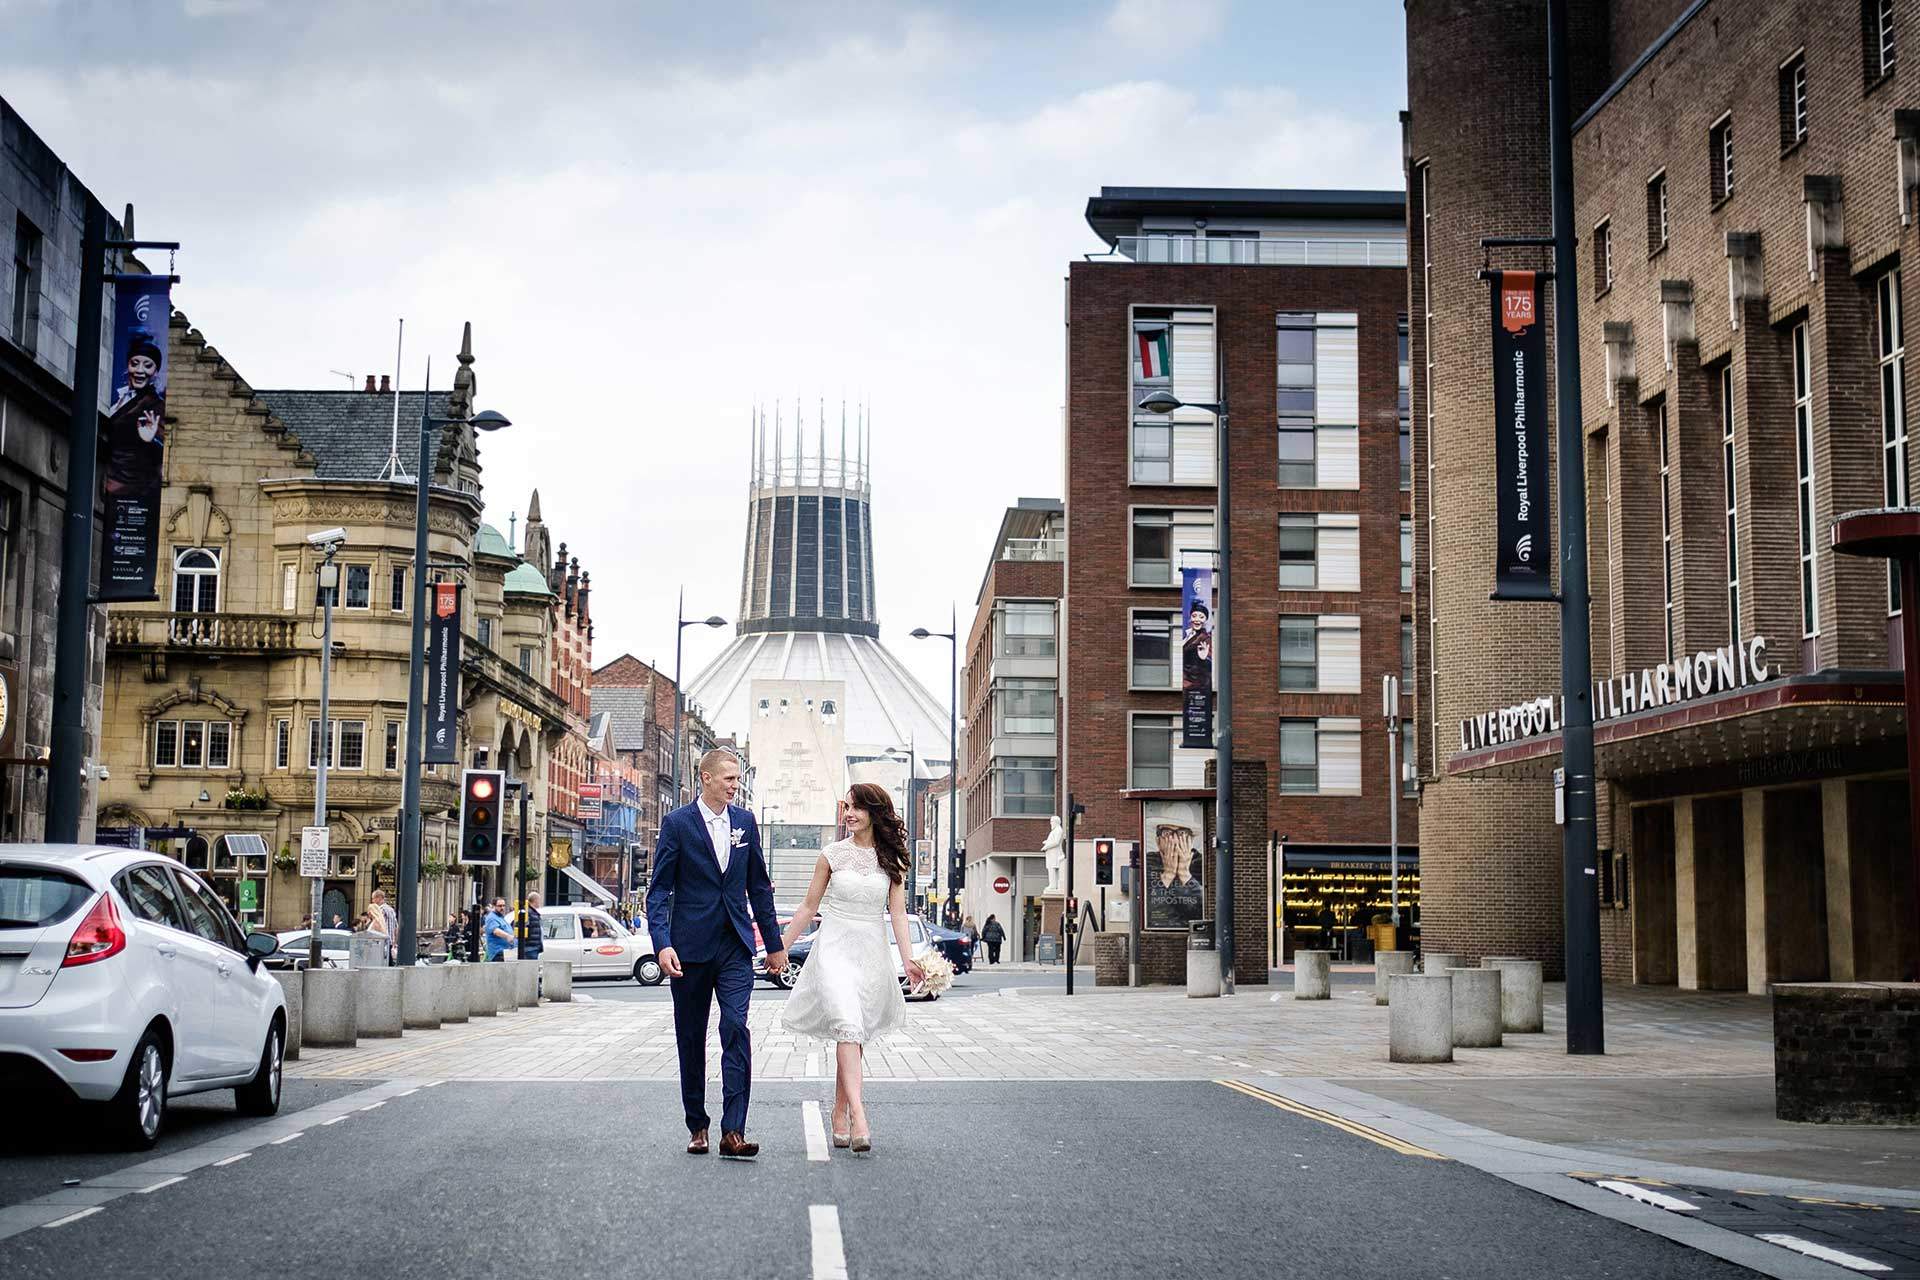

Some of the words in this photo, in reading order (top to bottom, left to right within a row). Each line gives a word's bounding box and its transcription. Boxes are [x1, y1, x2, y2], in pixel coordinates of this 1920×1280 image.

[1505, 296, 1531, 311] 175
[1506, 311, 1532, 319] YEARS
[1513, 350, 1525, 429] Philharmonic
[1515, 430, 1528, 486] Liverpool
[1516, 488, 1530, 521] Royal
[440, 596, 454, 605] 175
[440, 627, 448, 671] Philharmonic
[439, 671, 447, 702] Liverpool
[1461, 695, 1562, 751] LIVERPOOL
[1561, 635, 1768, 726] ILHARMONIC
[438, 703, 446, 721] Royal
[1151, 896, 1198, 905] IMPOSTERS
